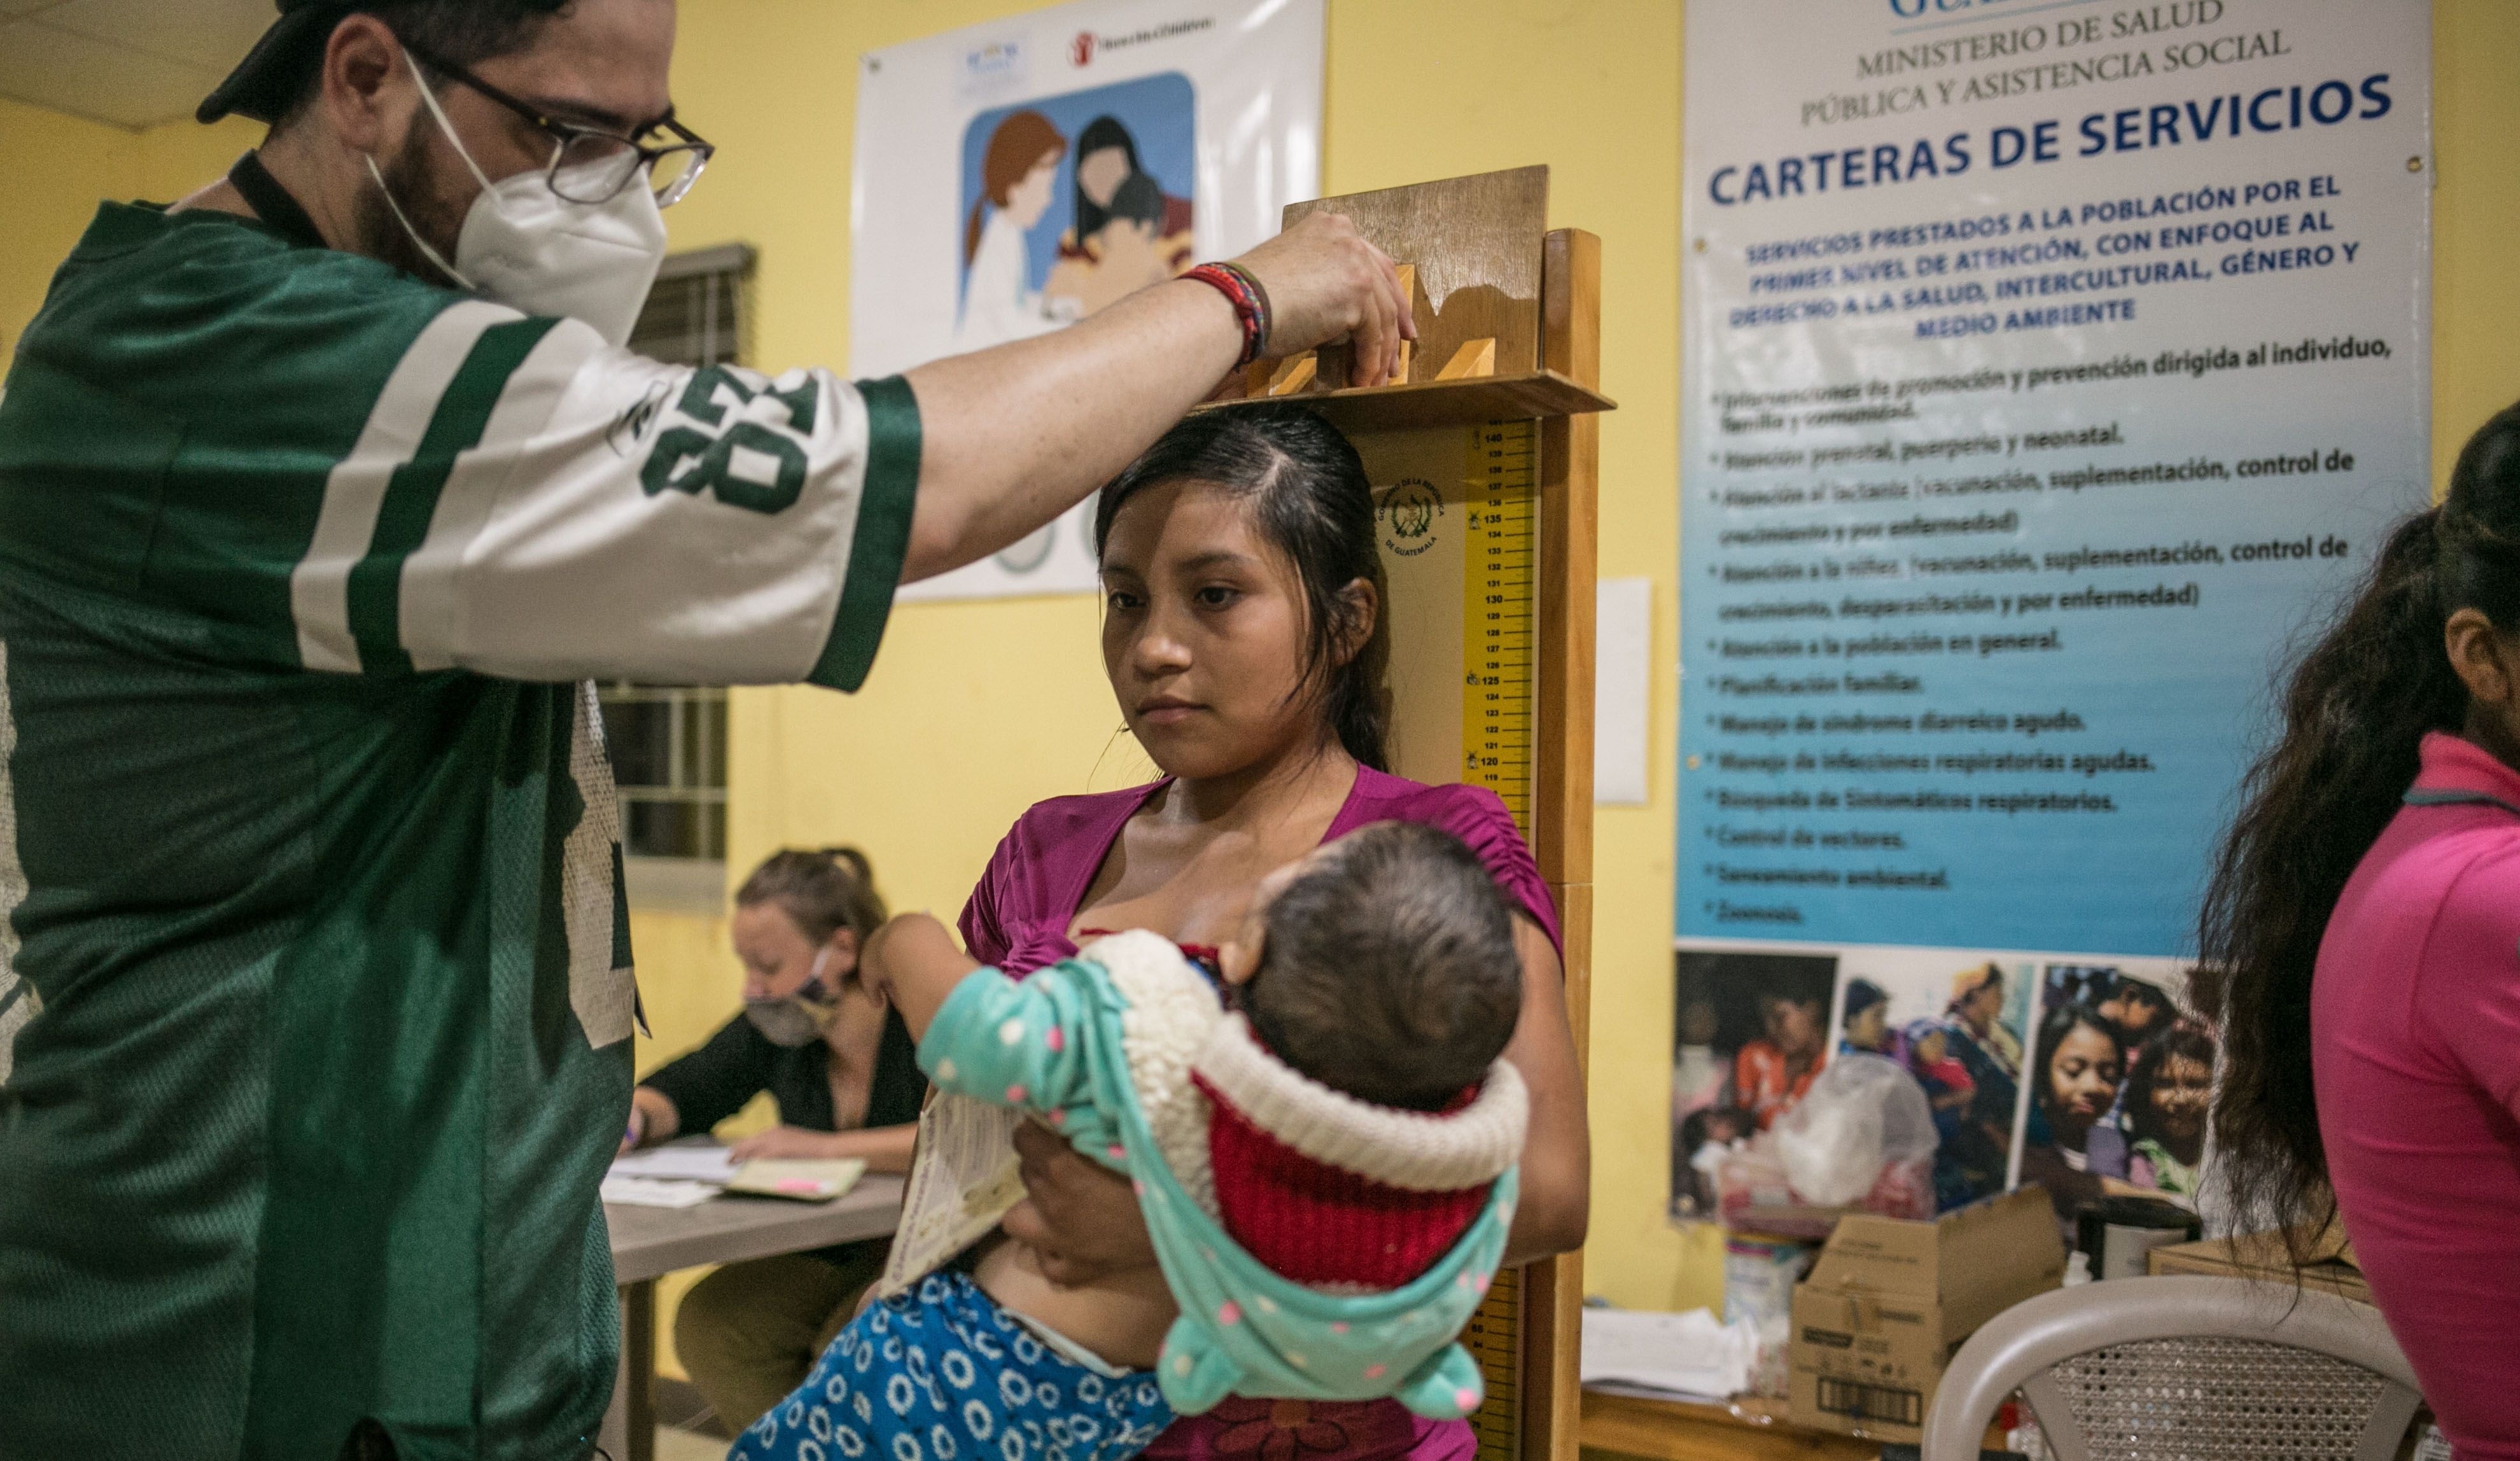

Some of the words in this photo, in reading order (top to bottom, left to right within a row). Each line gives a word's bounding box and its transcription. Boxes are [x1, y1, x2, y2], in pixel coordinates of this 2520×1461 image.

[1856, 25, 2047, 78] MINISTERIO
[2057, 17, 2103, 46] DE
[2111, 0, 2224, 37] SALUD
[1801, 87, 1928, 126] PÚBLICA
[1936, 80, 1957, 104] Y
[1963, 52, 2154, 102] ASISTENCIA
[2164, 29, 2291, 73] SOCIAL
[1709, 133, 1971, 206] CARTERAS
[1991, 120, 2061, 169] DE
[2078, 73, 2392, 158] SERVICIOS
[1745, 232, 1862, 266] SERVICIOS
[1869, 213, 2011, 249] PRESTADOS
[2017, 211, 2035, 232] A
[2041, 204, 2073, 230] LA
[2081, 185, 2236, 224] POBLACIÓN
[2244, 179, 2300, 206] POR
[2310, 175, 2341, 197] EL
[1842, 259, 1908, 285] NIVEL
[1915, 255, 1949, 277] DE
[1954, 235, 2089, 274] ATENCIÓN,
[2097, 232, 2151, 256] CON
[2160, 214, 2290, 249] ENFOQUE
[2299, 211, 2334, 233] AL
[1843, 295, 1858, 313] A
[1865, 293, 1894, 312] LA
[1903, 281, 1988, 312] SALUD,
[1996, 259, 2212, 298] INTERCULTURAL,
[2221, 239, 2335, 276] GÉNERO
[2342, 242, 2360, 262] Y
[1915, 313, 1996, 339] MEDIO
[2004, 298, 2135, 332] AMBIENTE
[2028, 354, 2148, 389] prevención
[2153, 346, 2240, 377] dirigida
[2246, 344, 2266, 365] al
[2272, 335, 2391, 363] individuo,
[2024, 421, 2124, 449] neonatal.
[2050, 456, 2230, 493] suplementación,
[2237, 449, 2318, 478] control
[2325, 448, 2353, 471] de
[1484, 515, 1501, 524] 135
[1488, 531, 1501, 539] 134
[1386, 539, 1395, 550] DE
[1395, 536, 1437, 556] GUATEMALA
[2044, 539, 2223, 574] suplementación,
[2231, 535, 2313, 563] control
[2319, 535, 2348, 558] de
[1485, 594, 1502, 604] 130
[2060, 582, 2199, 611] enfermedad)
[1487, 612, 1500, 620] 129
[1482, 676, 1499, 685] 125
[1486, 693, 1499, 701] 124
[1481, 757, 1498, 766] 120
